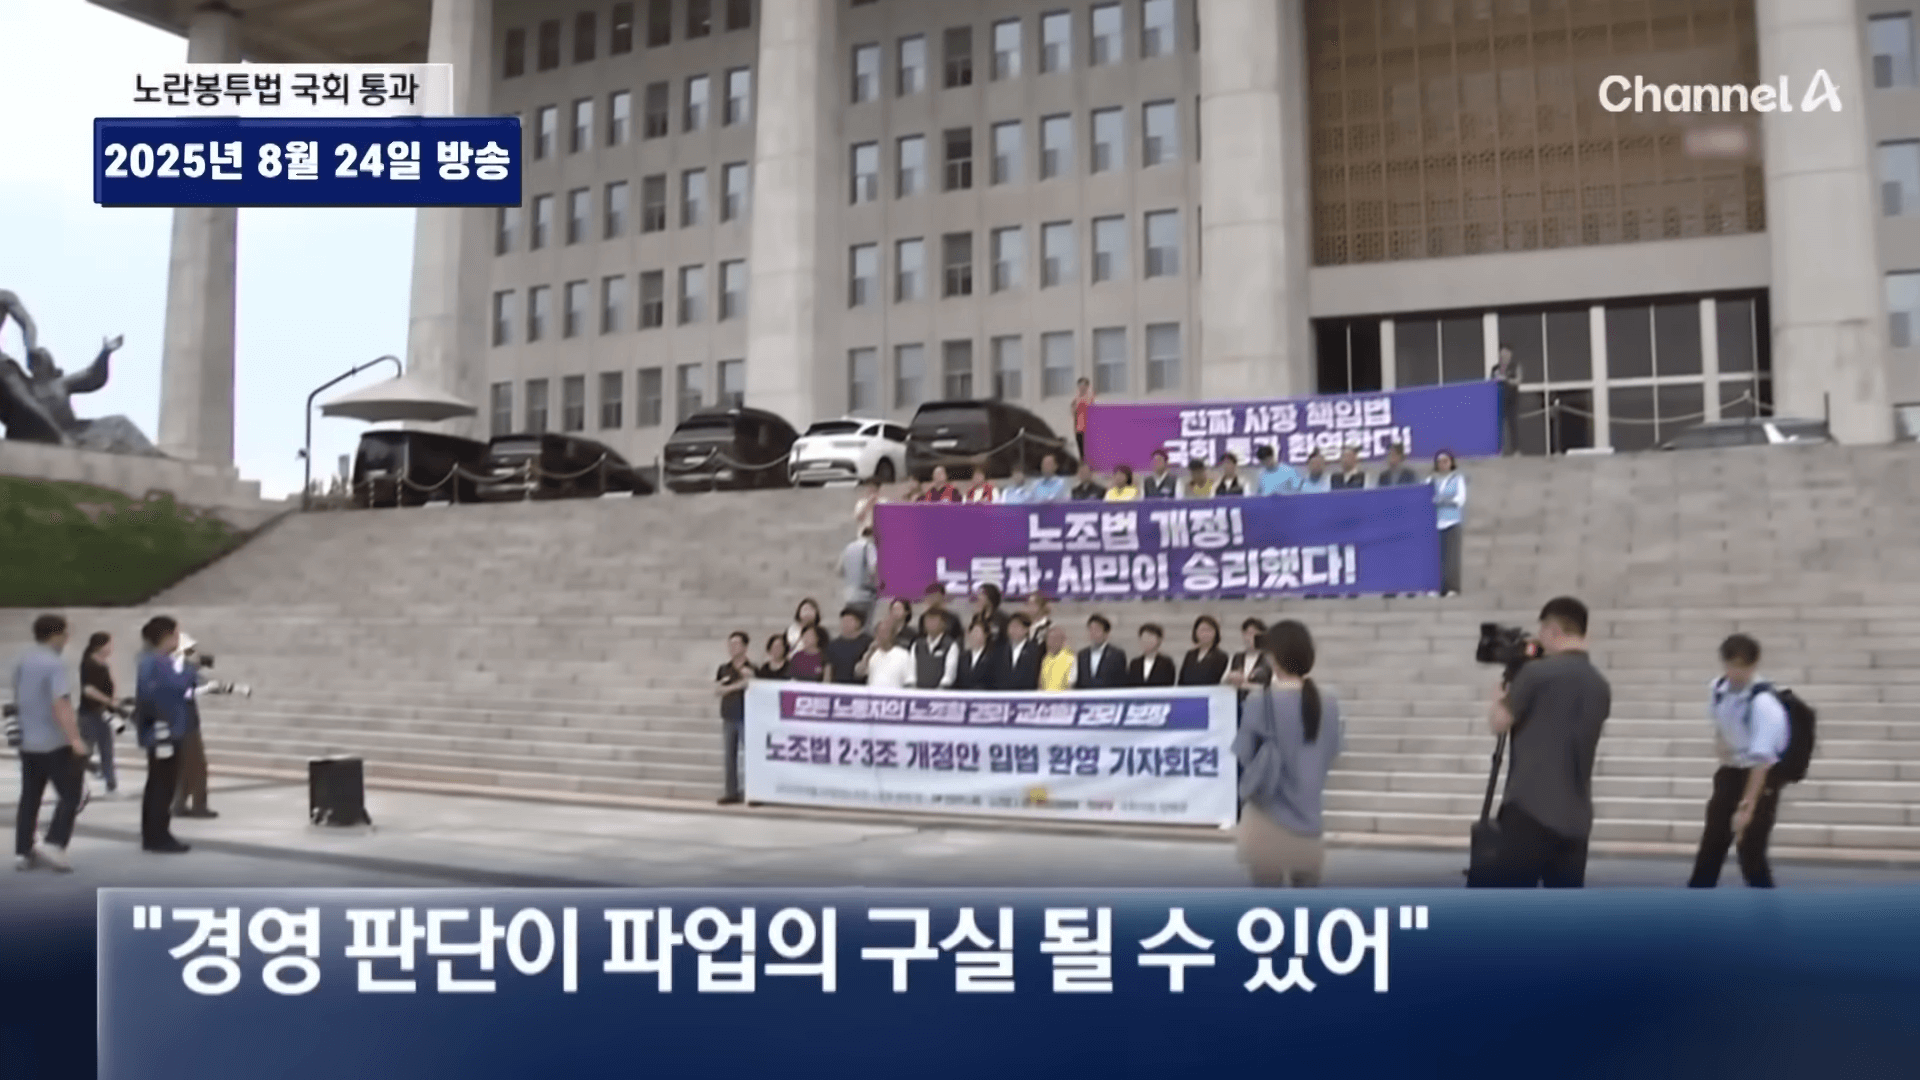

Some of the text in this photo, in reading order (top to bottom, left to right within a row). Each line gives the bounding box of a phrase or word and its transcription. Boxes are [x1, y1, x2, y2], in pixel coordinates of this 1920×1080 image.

[1179, 397, 1391, 437] 진짜 사장 책임법
[1028, 507, 1244, 551] 노조법 개정!
[1182, 544, 1356, 590] 승리했다!
[766, 733, 1219, 777] 노조법 2·3조 개정안 입법 환영 기자회견
